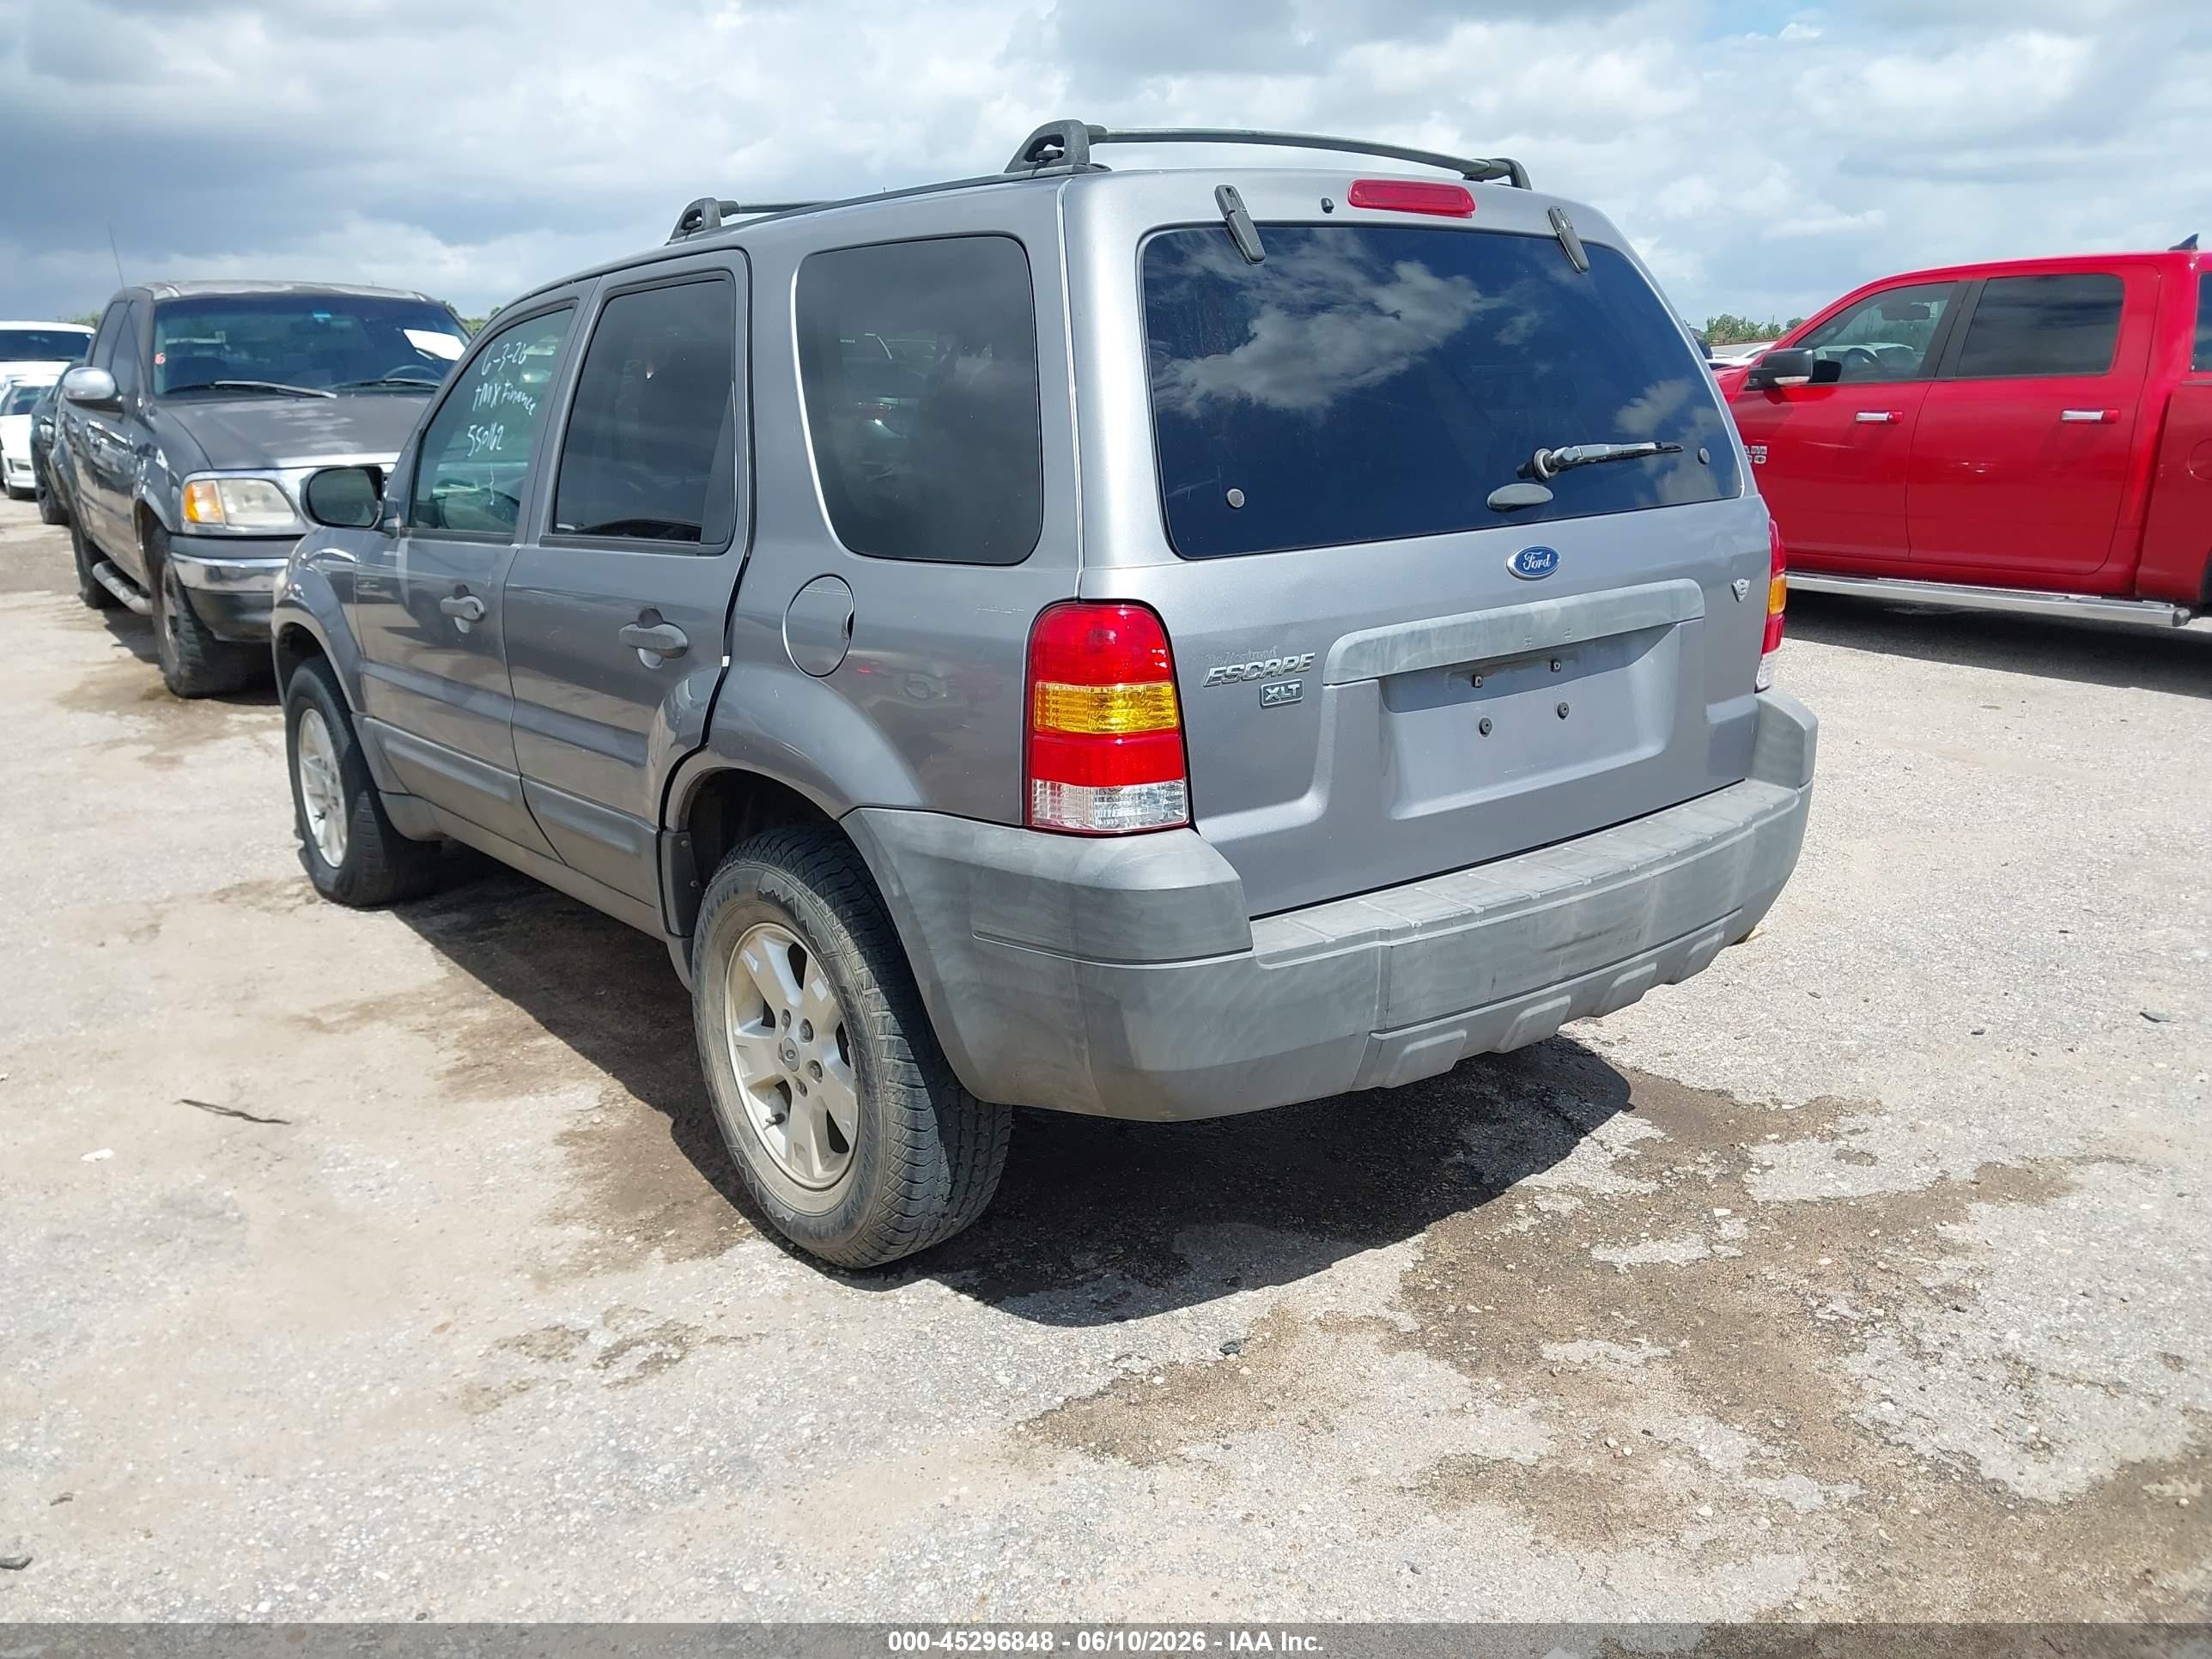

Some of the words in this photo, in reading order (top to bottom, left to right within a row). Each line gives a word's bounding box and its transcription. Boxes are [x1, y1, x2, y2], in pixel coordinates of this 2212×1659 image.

[1522, 551, 1551, 570] Ford
[1204, 653, 1316, 687] ESCAPE
[1265, 684, 1300, 701] XLT
